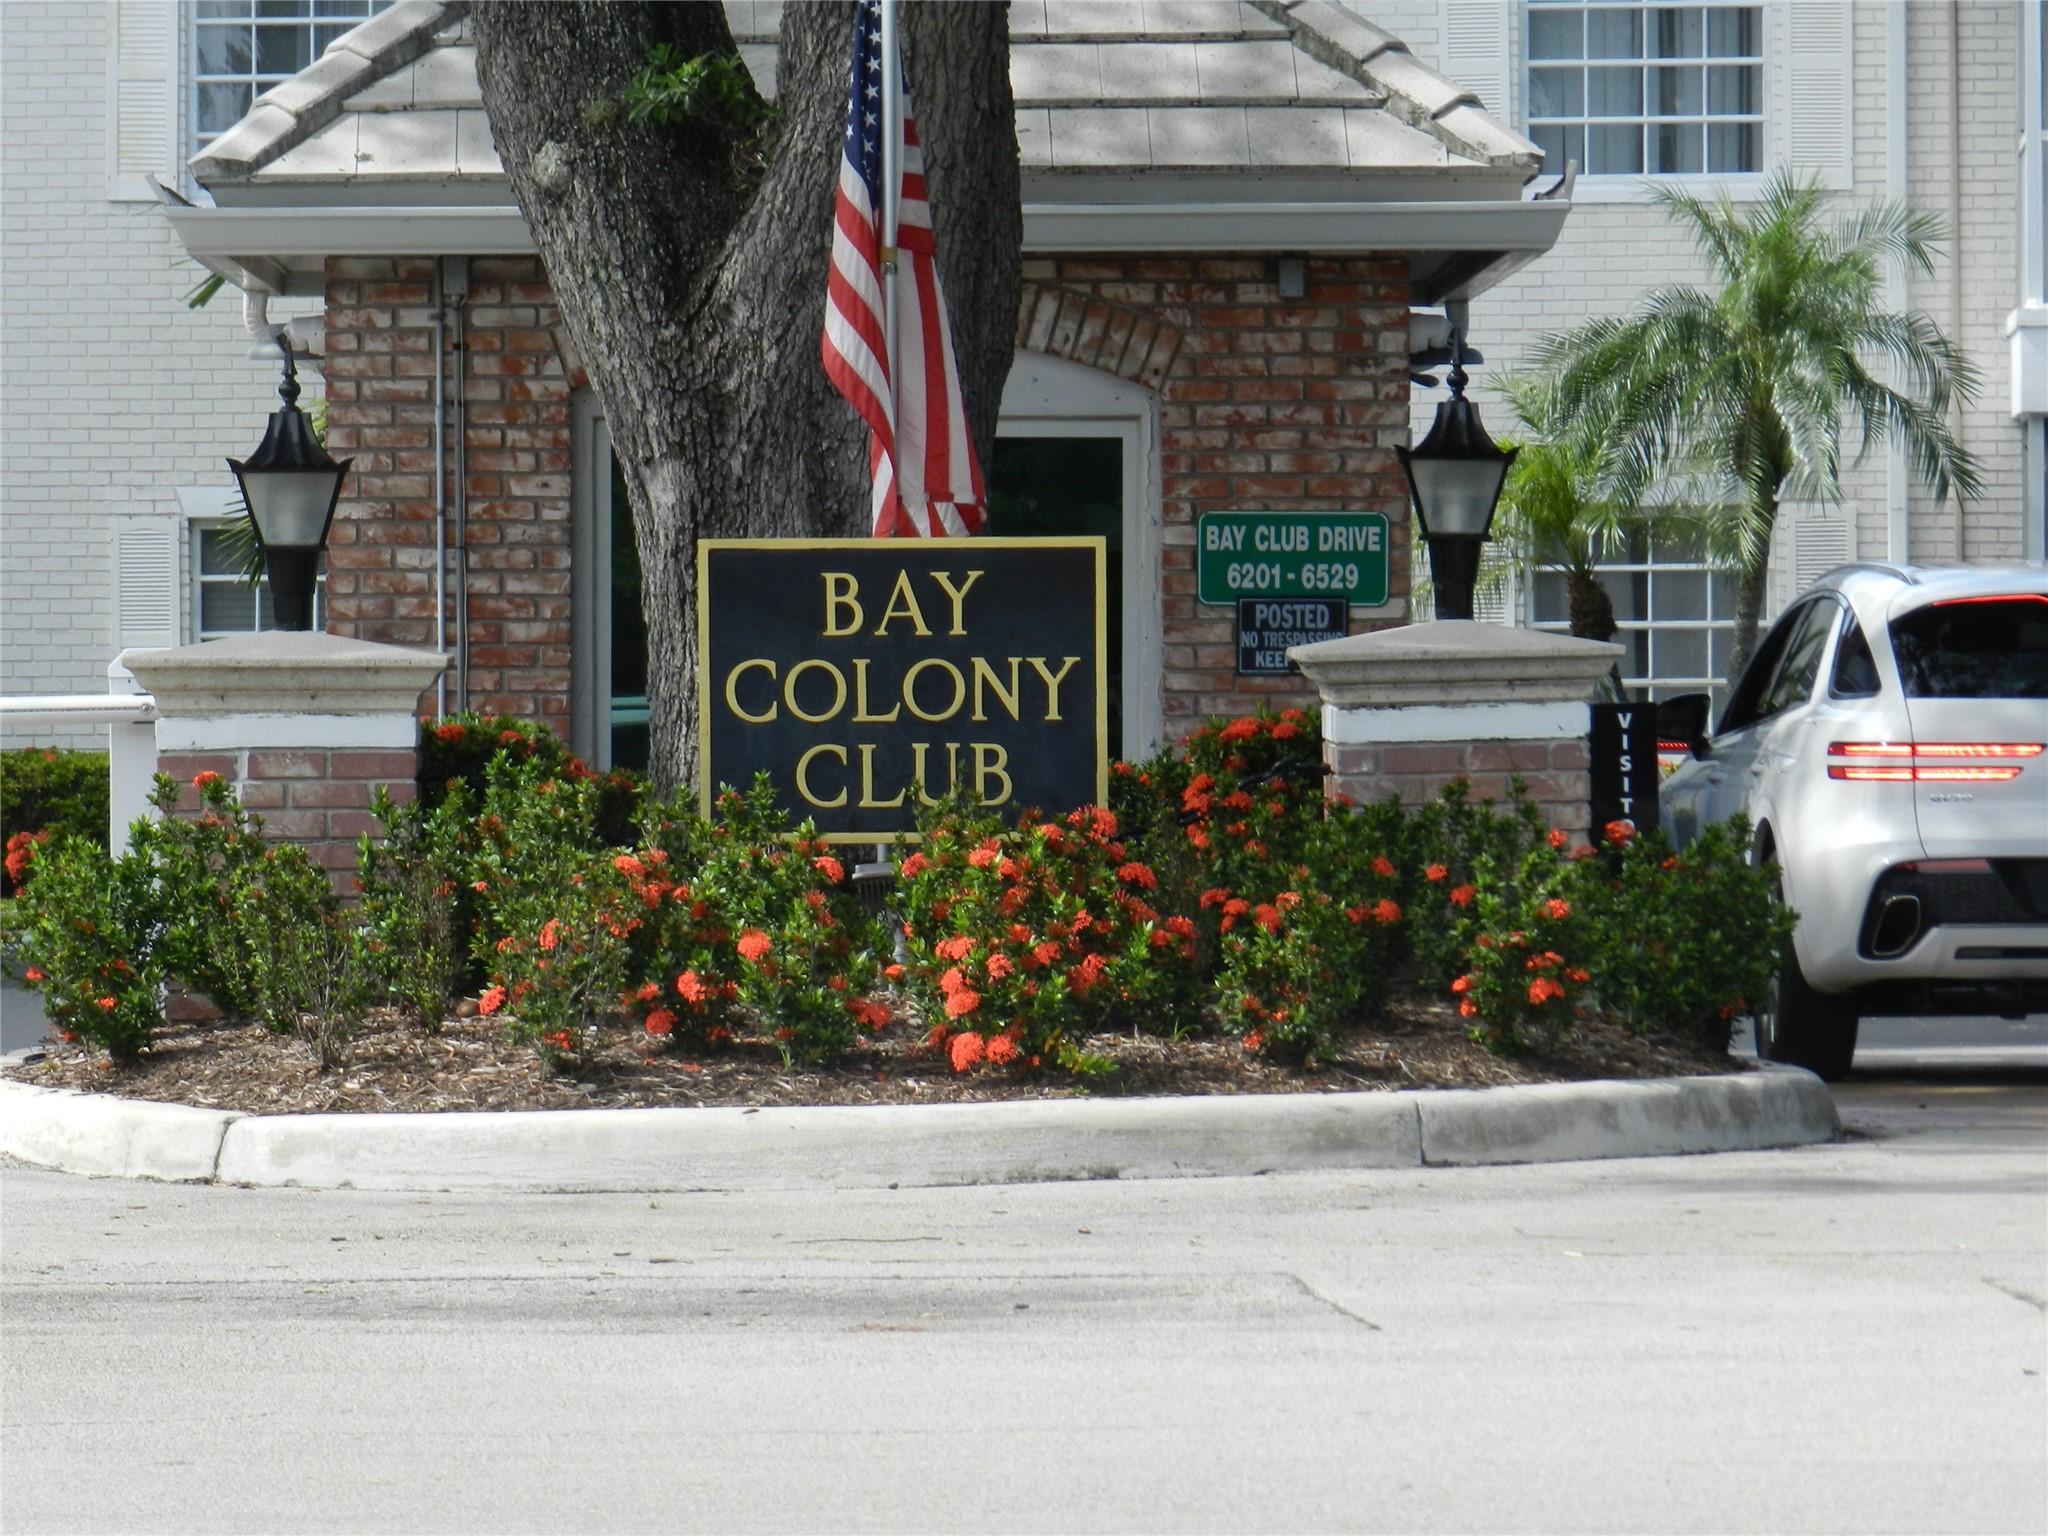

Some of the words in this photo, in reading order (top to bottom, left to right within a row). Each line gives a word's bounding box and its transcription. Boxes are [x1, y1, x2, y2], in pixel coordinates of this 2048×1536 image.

[1206, 525, 1246, 552] BAY
[1255, 525, 1310, 552] CLUB
[1318, 526, 1382, 552] DRIVE
[1227, 563, 1281, 589] 6201
[1301, 563, 1359, 590] 6529
[821, 568, 985, 636] BAY
[1256, 604, 1329, 629] POSTED
[1241, 632, 1258, 647] NO
[725, 656, 1082, 724] COLONY
[795, 743, 1013, 809] CLUB
[1617, 712, 1635, 848] VISIT
